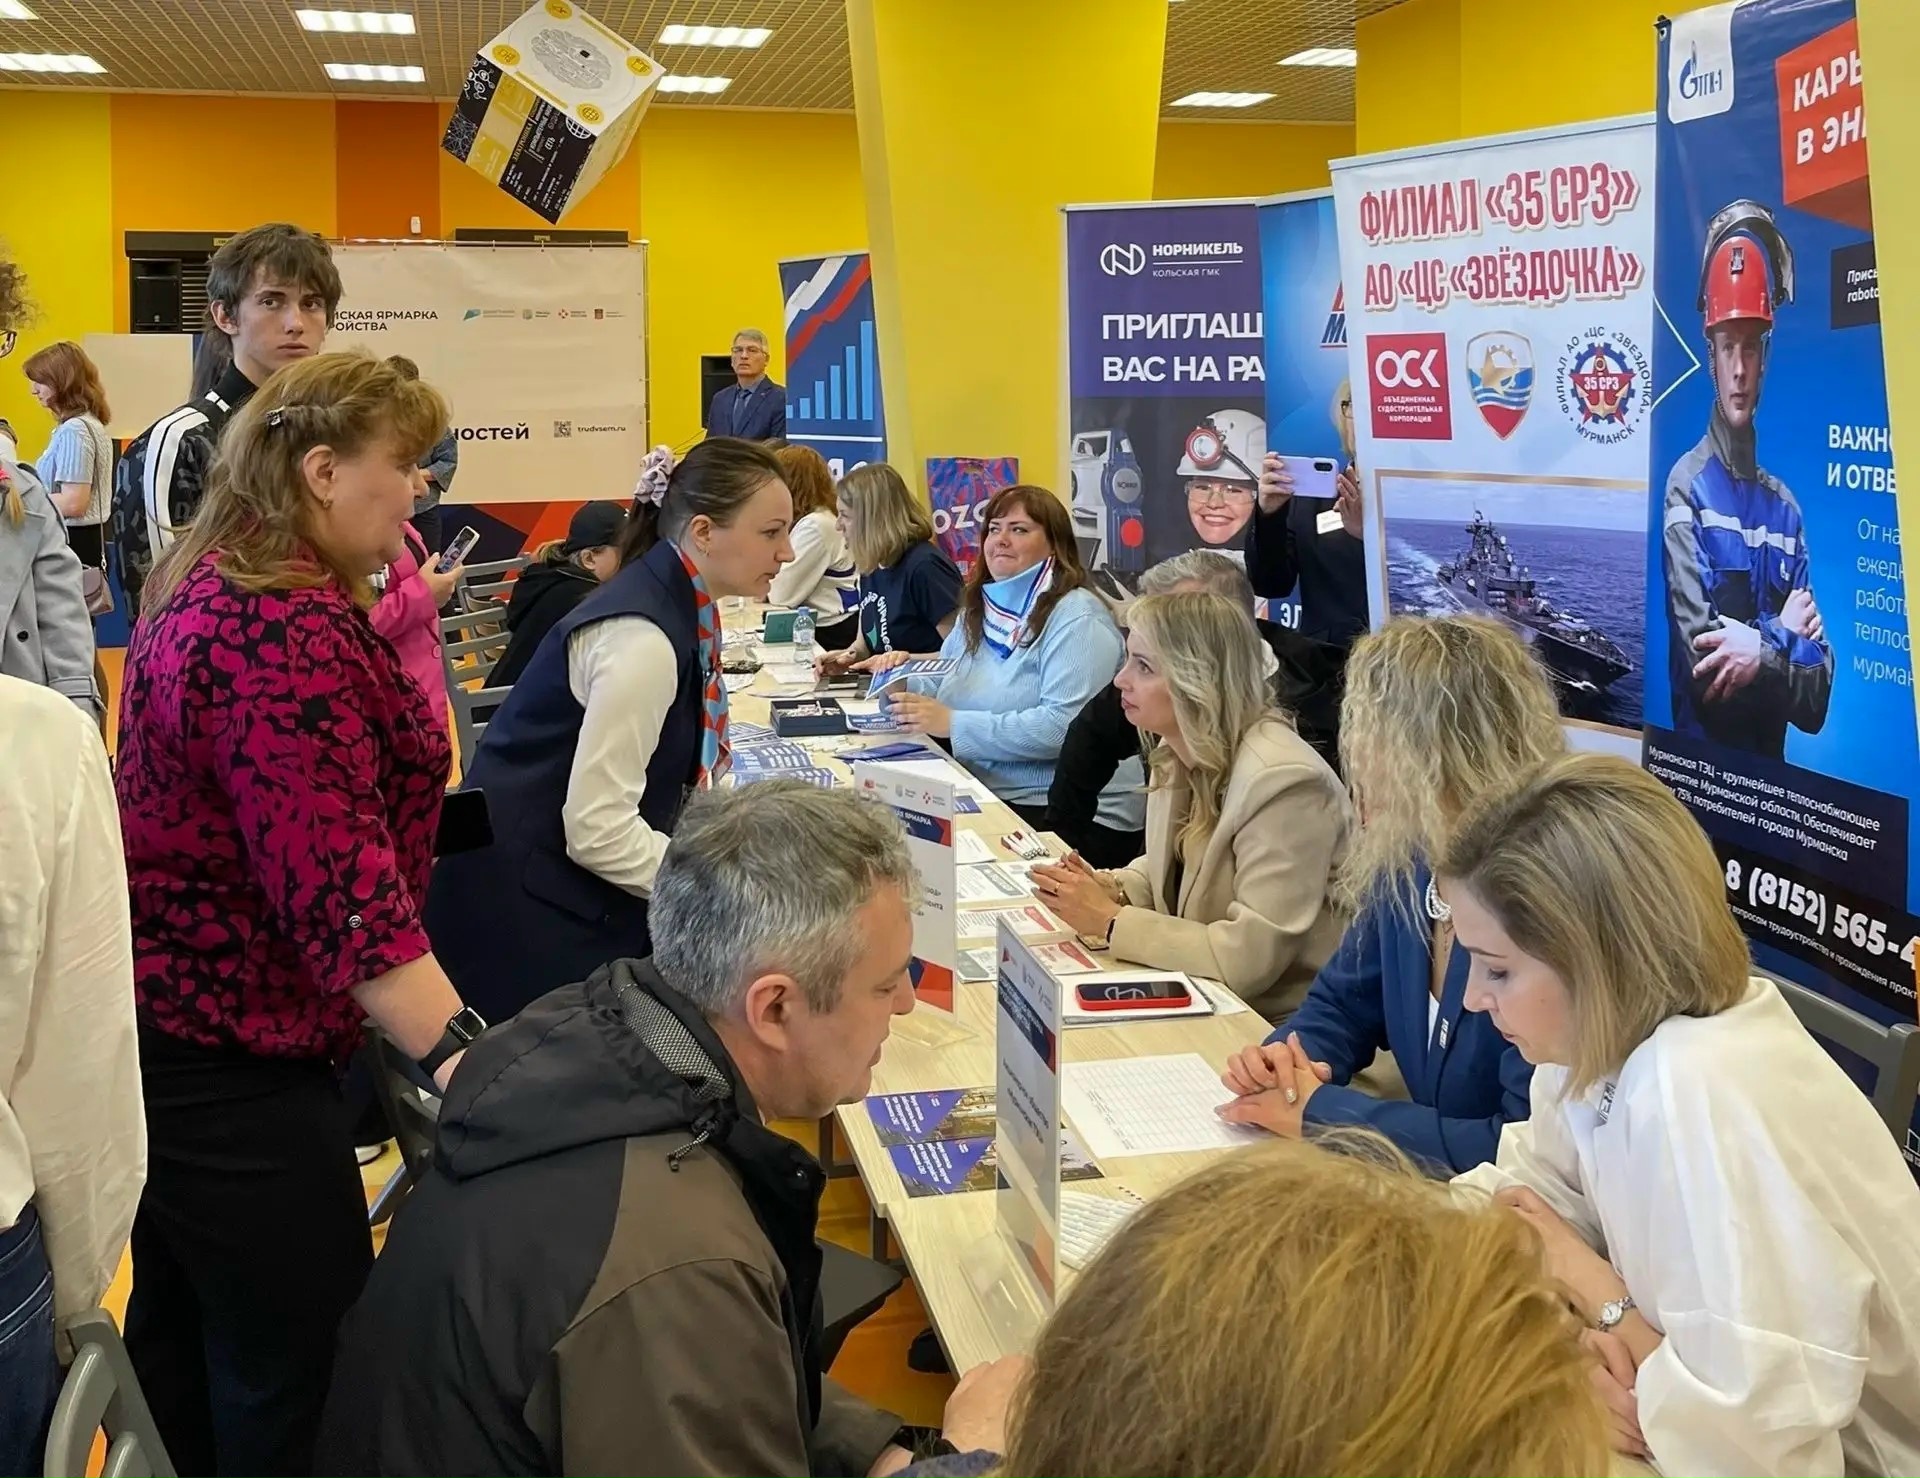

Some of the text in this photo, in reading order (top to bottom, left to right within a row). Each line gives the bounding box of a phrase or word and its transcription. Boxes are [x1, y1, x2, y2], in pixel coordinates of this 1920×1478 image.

[1796, 106, 1867, 165] В ЭН
[1360, 162, 1636, 241] ФИЛИАЛ «35 СРЗ»
[1153, 243, 1243, 256] НОРНИКЕЛЬ
[1153, 268, 1220, 277] КОЛЬСКАЯ ГМК
[1365, 246, 1639, 307] АО «ЦС «ЗВЁЗДОЧКА»
[376, 311, 438, 319] ЯРМАРКА
[1102, 312, 1264, 339] ПРИГЛАШ
[1103, 355, 1266, 381] ВАС НА РА
[1375, 349, 1440, 388] ОСК
[1556, 356, 1569, 414] ФИЛИАЛ
[1566, 336, 1580, 353] АО
[1584, 326, 1605, 338] «ЦС
[1584, 376, 1619, 390] 35 СРЗ
[1377, 405, 1443, 413] СУДОСТРОИТЕЛЬНАЯ
[1389, 415, 1432, 423] КОРПОРАЦИЯ
[1575, 424, 1635, 444] МУРМАНСК
[1828, 424, 1892, 453] ВАЖН
[1827, 462, 1841, 488] И
[1857, 518, 1901, 545] От на
[1649, 745, 1697, 770] Мурманская
[1698, 760, 1715, 779] ТЭЦ
[1723, 769, 1785, 798] крупнейшее
[1786, 791, 1881, 831] теплоснабжающее
[1648, 762, 1699, 788] предприятие
[1700, 779, 1759, 808] Мурманской
[1803, 814, 1878, 851] Обеспечивает
[1677, 787, 1692, 803] 75%
[1693, 796, 1756, 826] потребителей
[1758, 818, 1795, 839] города
[1795, 829, 1849, 862] Мурманска
[1725, 859, 1741, 890] 8
[1749, 867, 1826, 936] (8152)
[1732, 905, 1768, 928] вопросам
[1768, 921, 1830, 958] трудоустройства
[1835, 954, 1888, 987] прохождения
